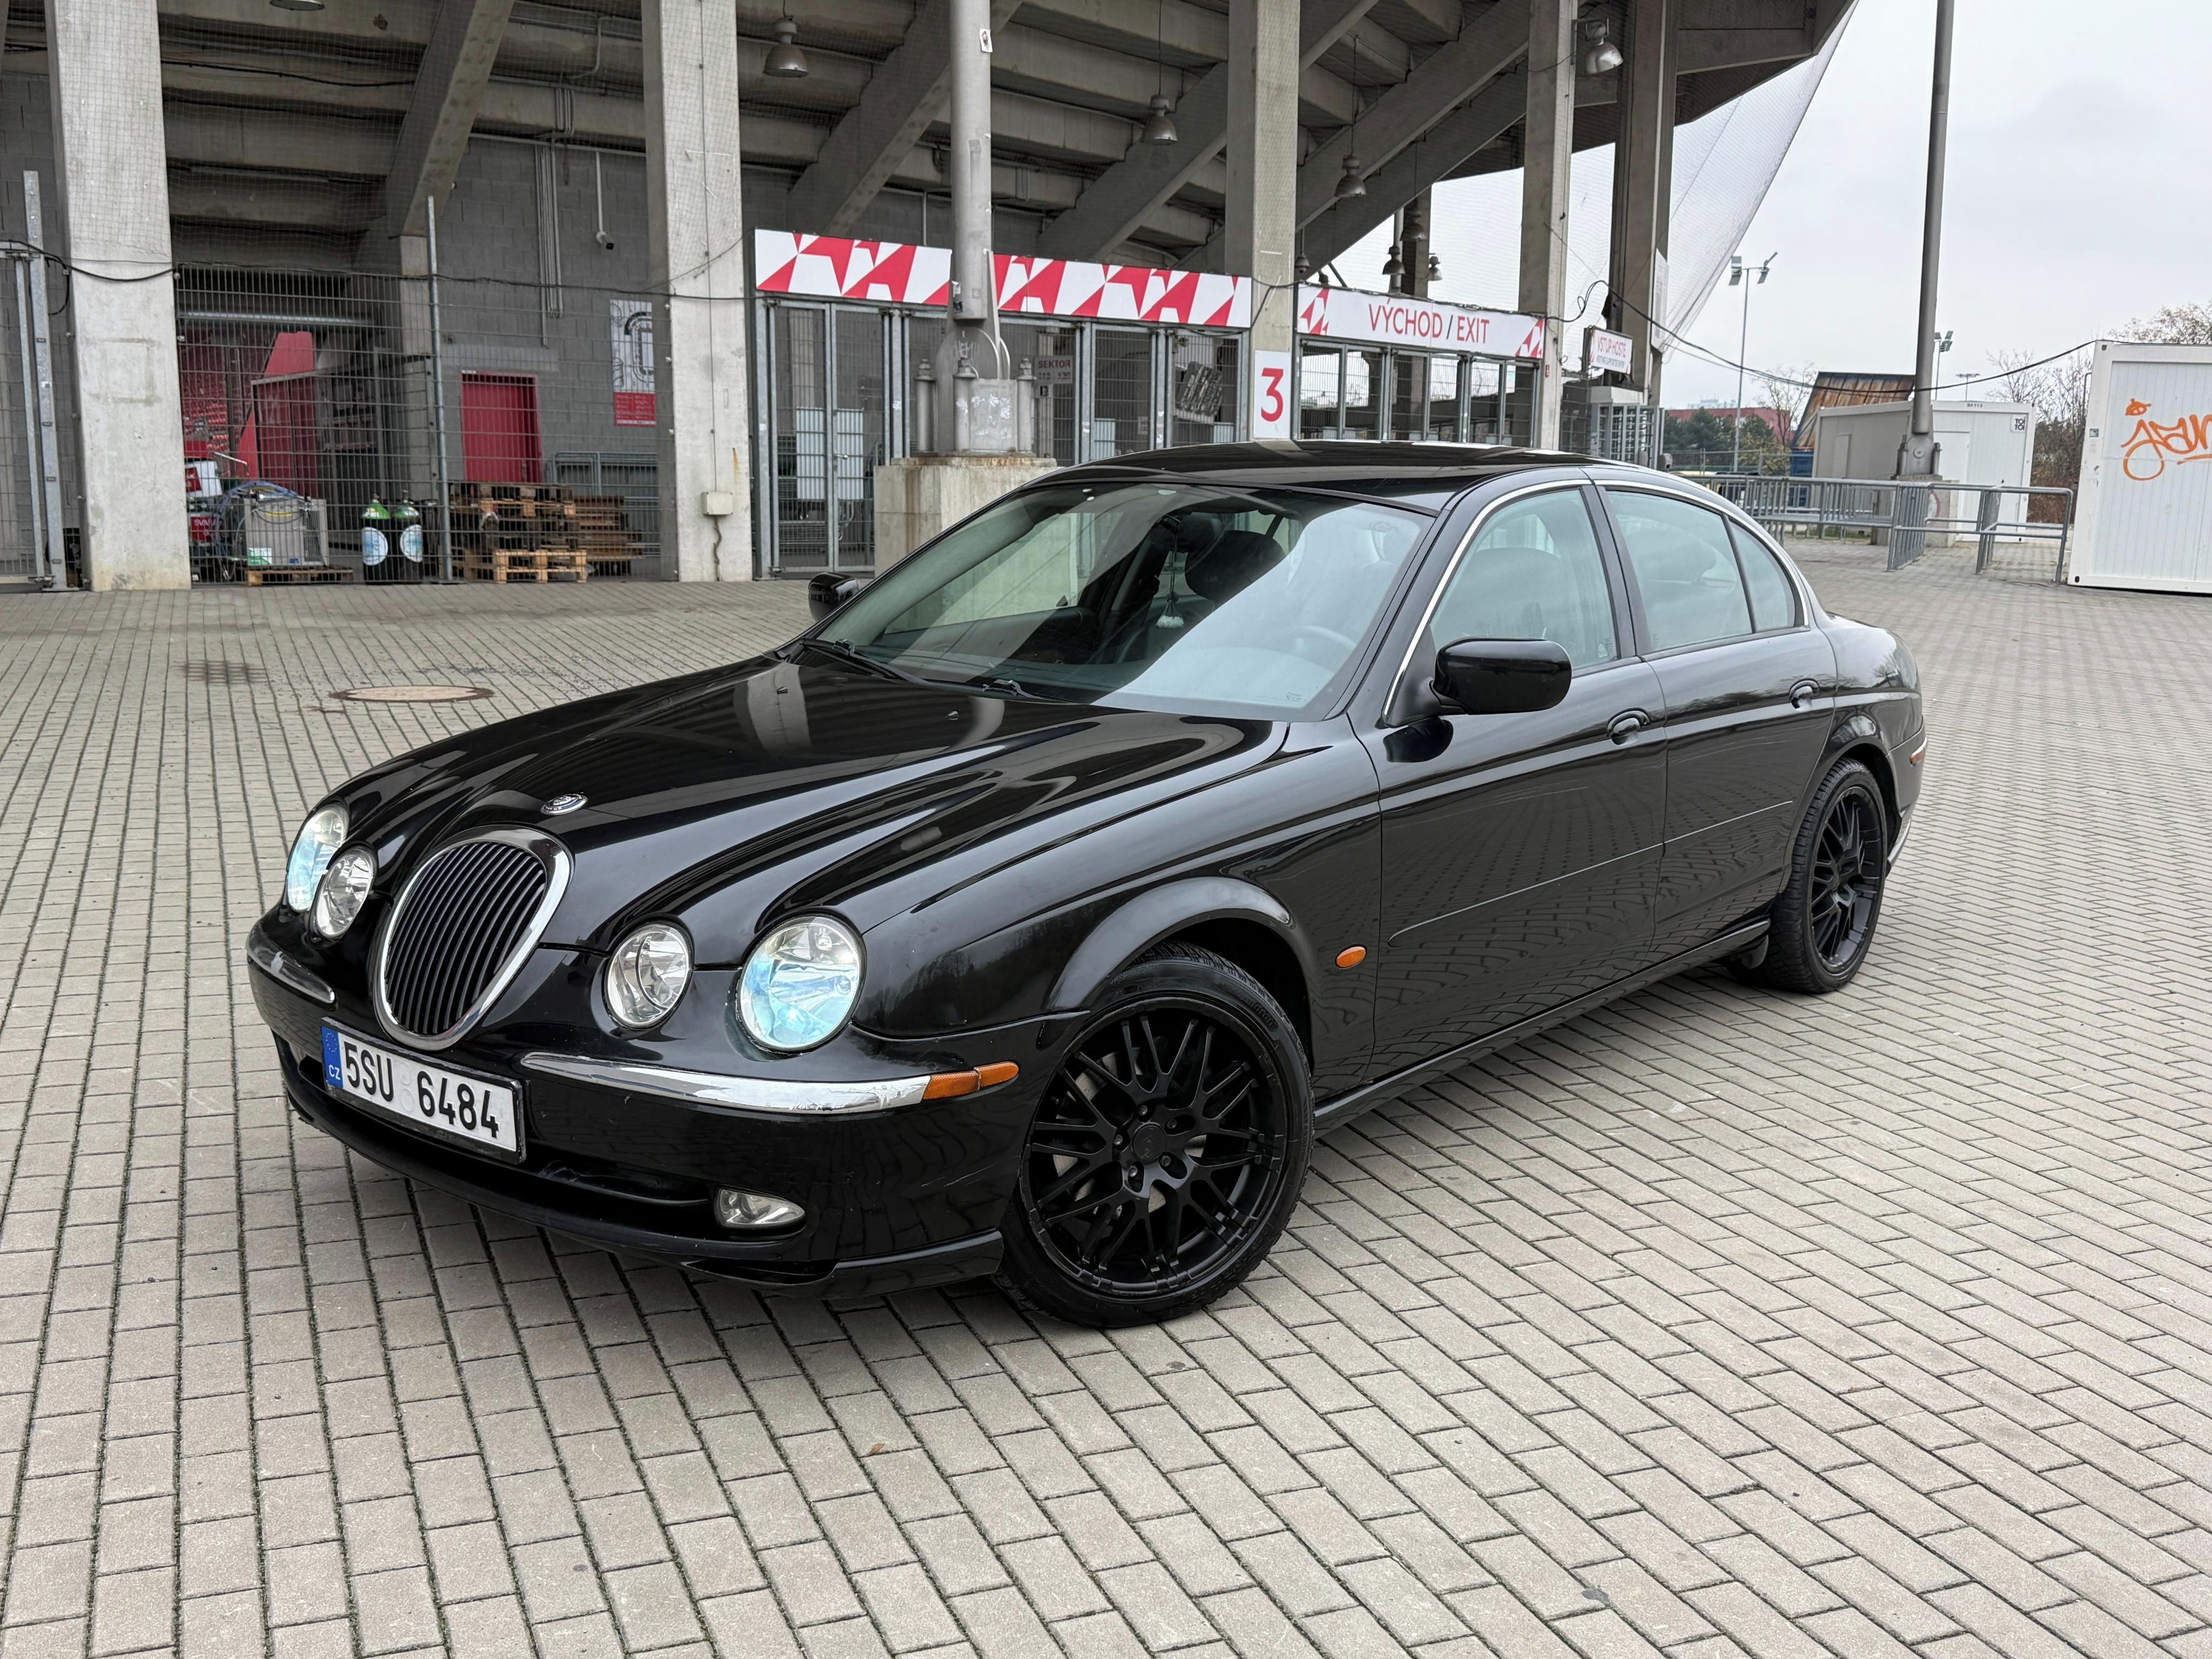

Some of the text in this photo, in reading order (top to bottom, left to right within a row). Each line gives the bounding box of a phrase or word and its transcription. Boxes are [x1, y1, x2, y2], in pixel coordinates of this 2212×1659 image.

[1368, 298, 1442, 338] VÝCHOD
[1457, 315, 1489, 344] EXIT
[1037, 360, 1071, 368] SEKTOR
[1261, 367, 1284, 422] 3
[328, 1064, 341, 1080] CZ
[343, 1041, 499, 1139] 5SU 6484
